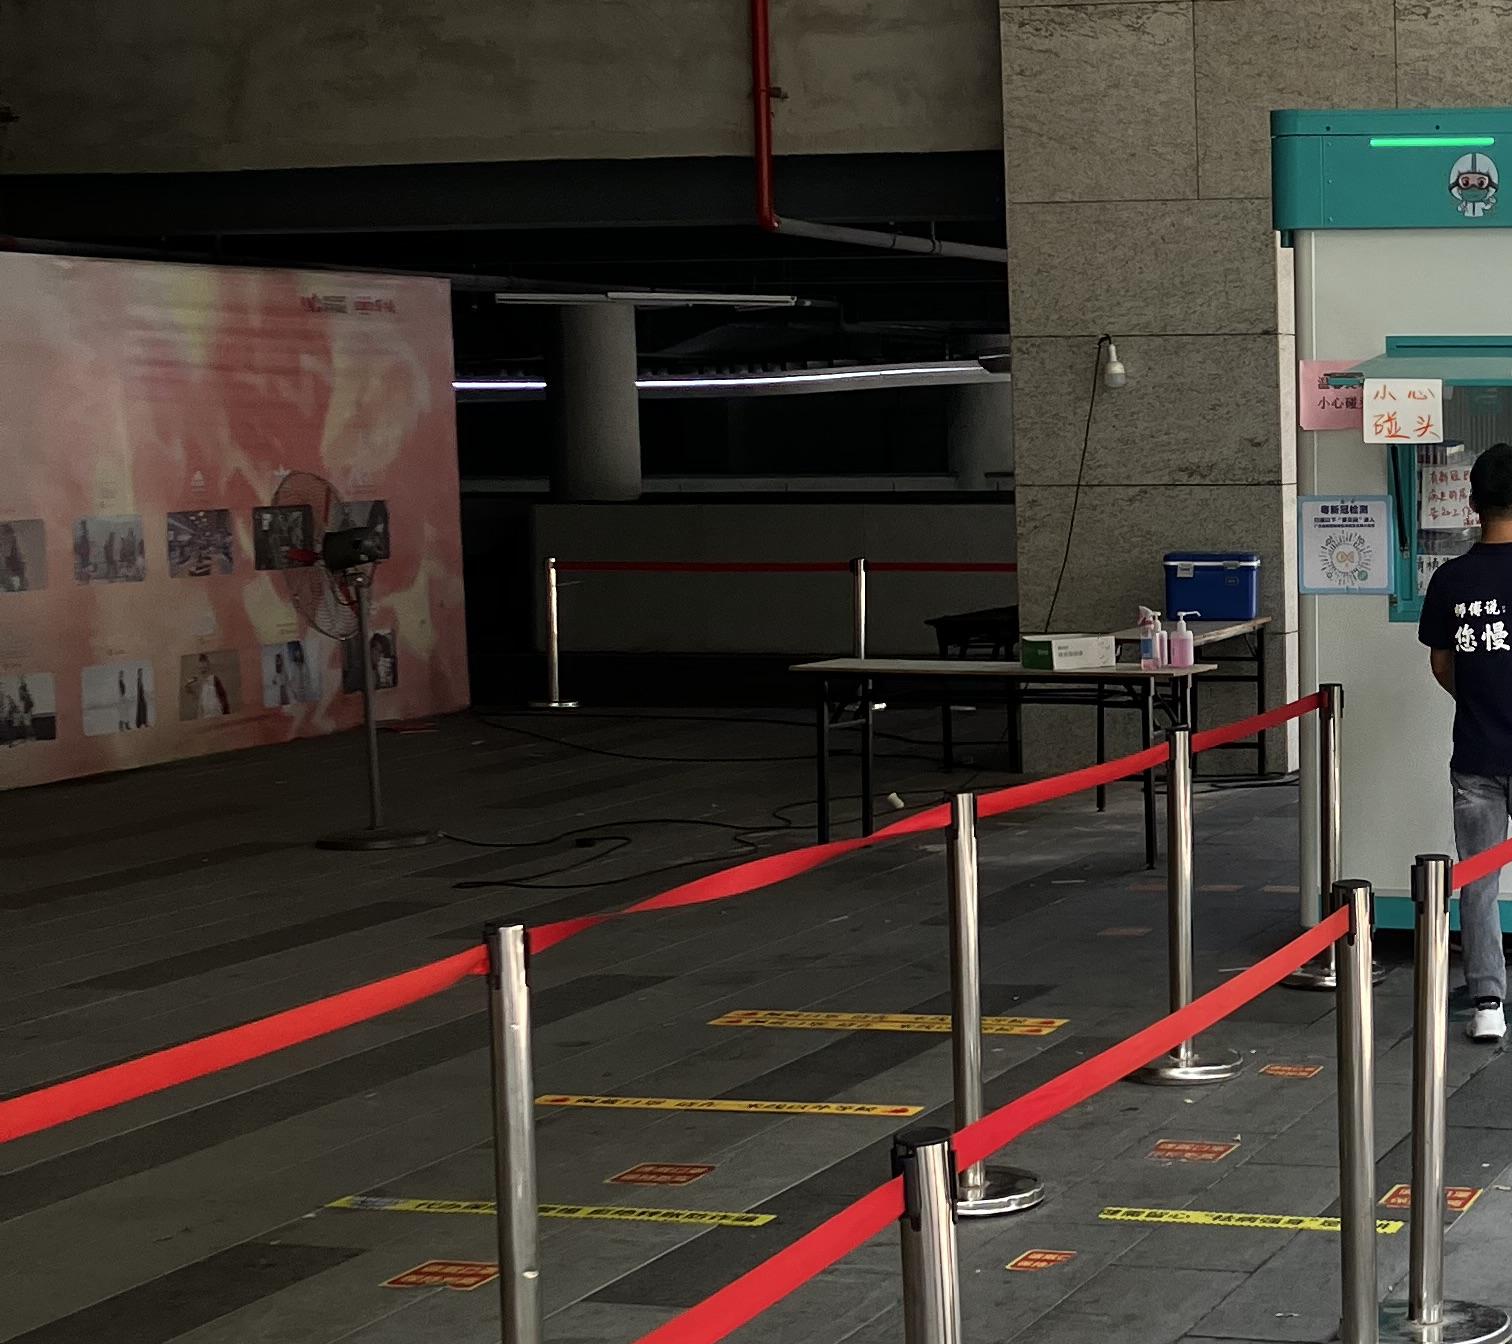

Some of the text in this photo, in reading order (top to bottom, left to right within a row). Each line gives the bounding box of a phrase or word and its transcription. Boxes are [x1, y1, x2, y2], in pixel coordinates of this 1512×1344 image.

[1373, 384, 1436, 401] 小心
[1317, 396, 1364, 410] 小心碰
[1373, 411, 1440, 439] 碰头
